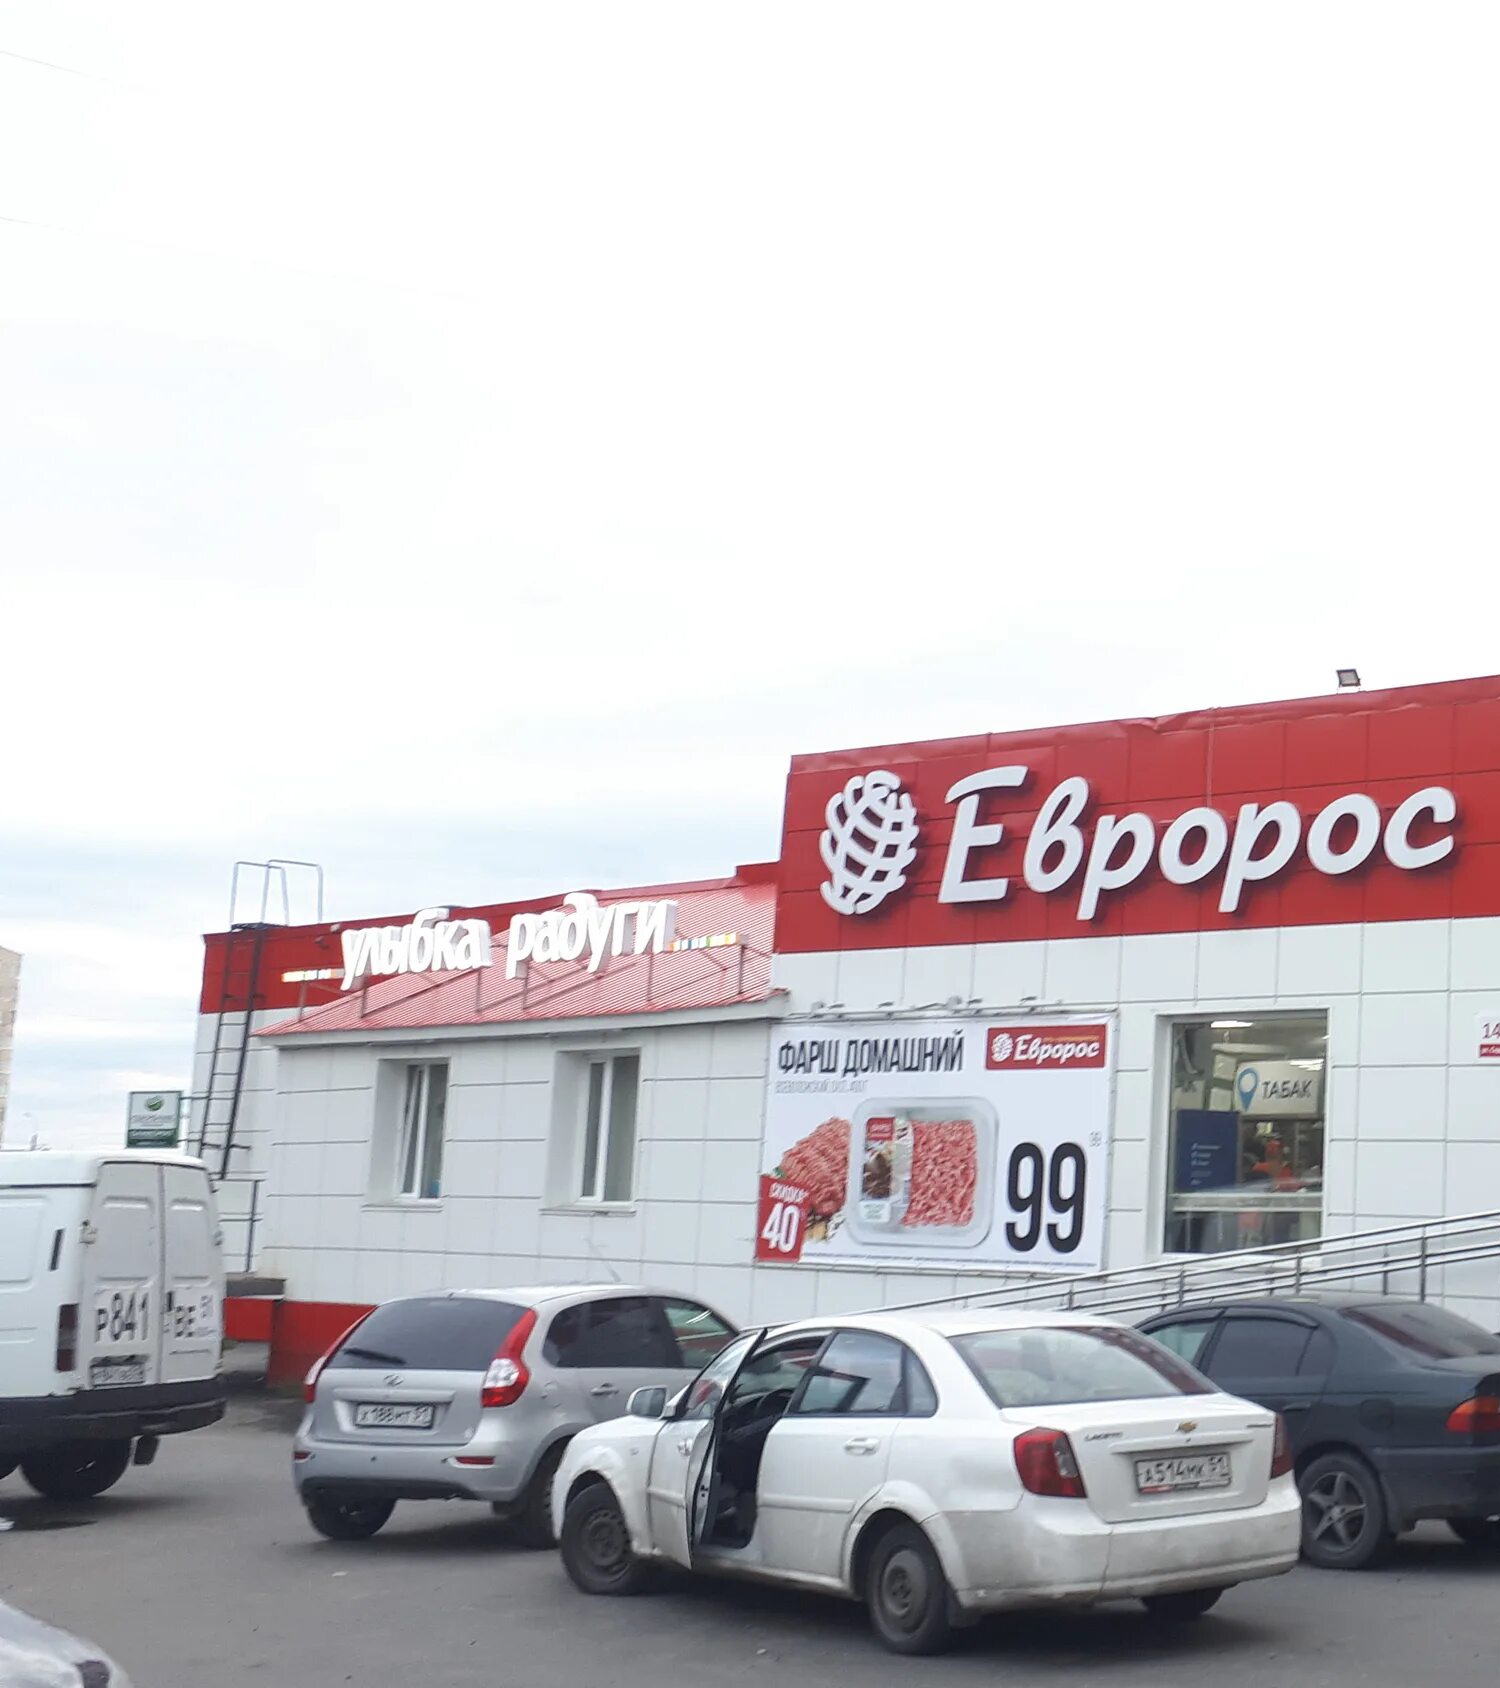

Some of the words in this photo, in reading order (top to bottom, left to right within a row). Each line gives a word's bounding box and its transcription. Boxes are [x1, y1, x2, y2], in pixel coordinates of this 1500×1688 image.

[938, 765, 1457, 920] Евророс
[340, 907, 490, 991] улыбка
[504, 892, 678, 981] радуги
[777, 1040, 840, 1074] ФАРШ
[841, 1028, 965, 1078] ДОМАШНИЙ
[1012, 1032, 1101, 1065] Евророс
[1262, 1079, 1312, 1099] ТАБАК
[1005, 1141, 1086, 1254] 99
[760, 1201, 801, 1254] 40
[94, 1292, 148, 1343] Р841
